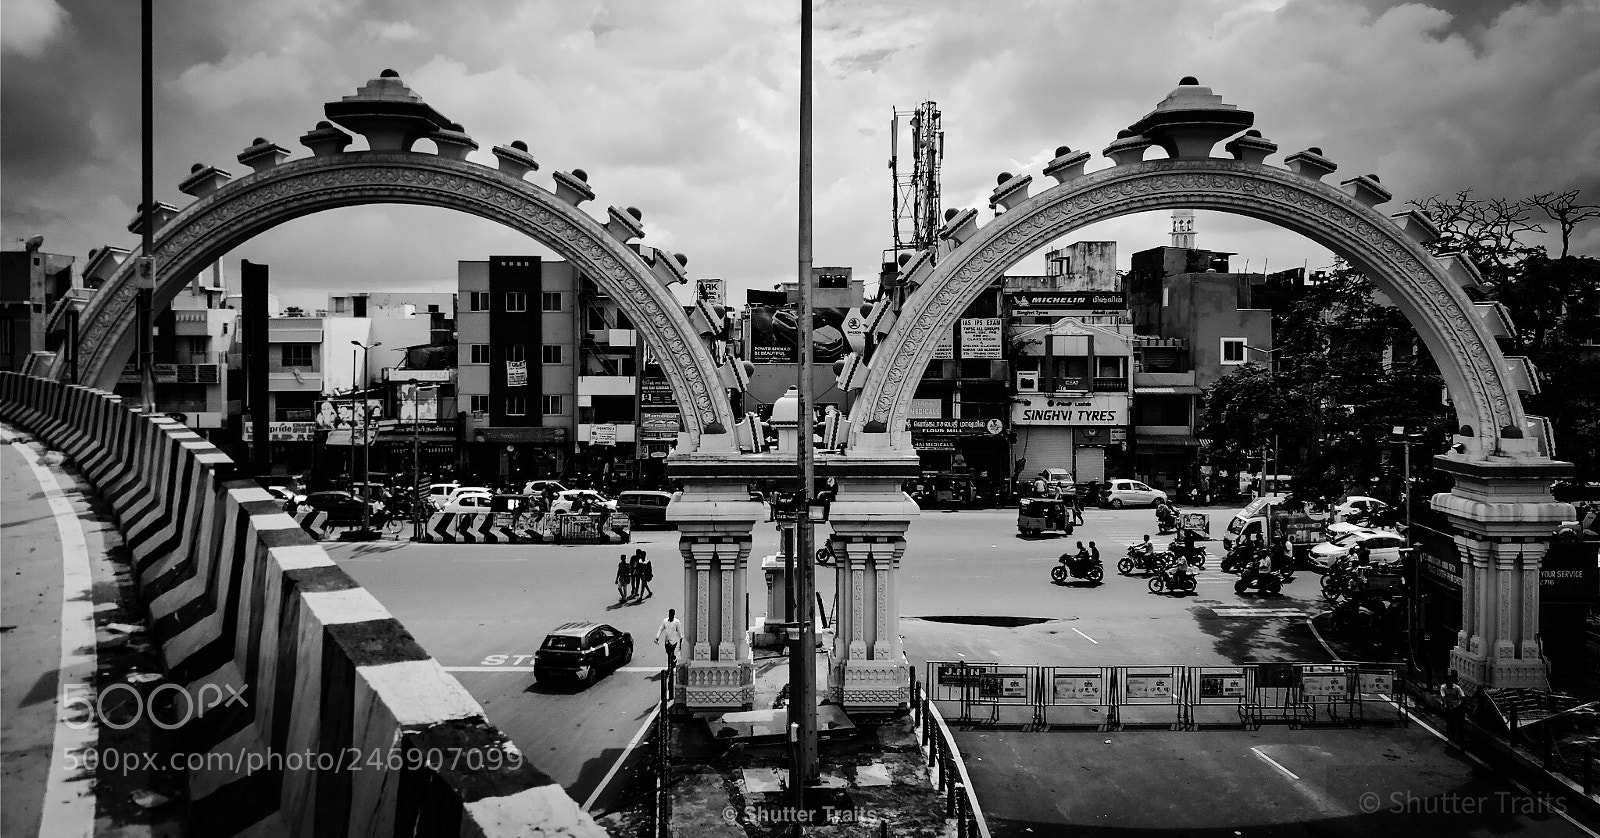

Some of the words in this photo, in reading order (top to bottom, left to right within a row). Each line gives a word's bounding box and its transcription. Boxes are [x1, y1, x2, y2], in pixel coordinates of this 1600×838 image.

[1022, 410, 1073, 421] SINGHVI
[1077, 410, 1117, 421] TYRES
[1540, 570, 1556, 578] YOUR
[1556, 570, 1583, 578] SERVICE
